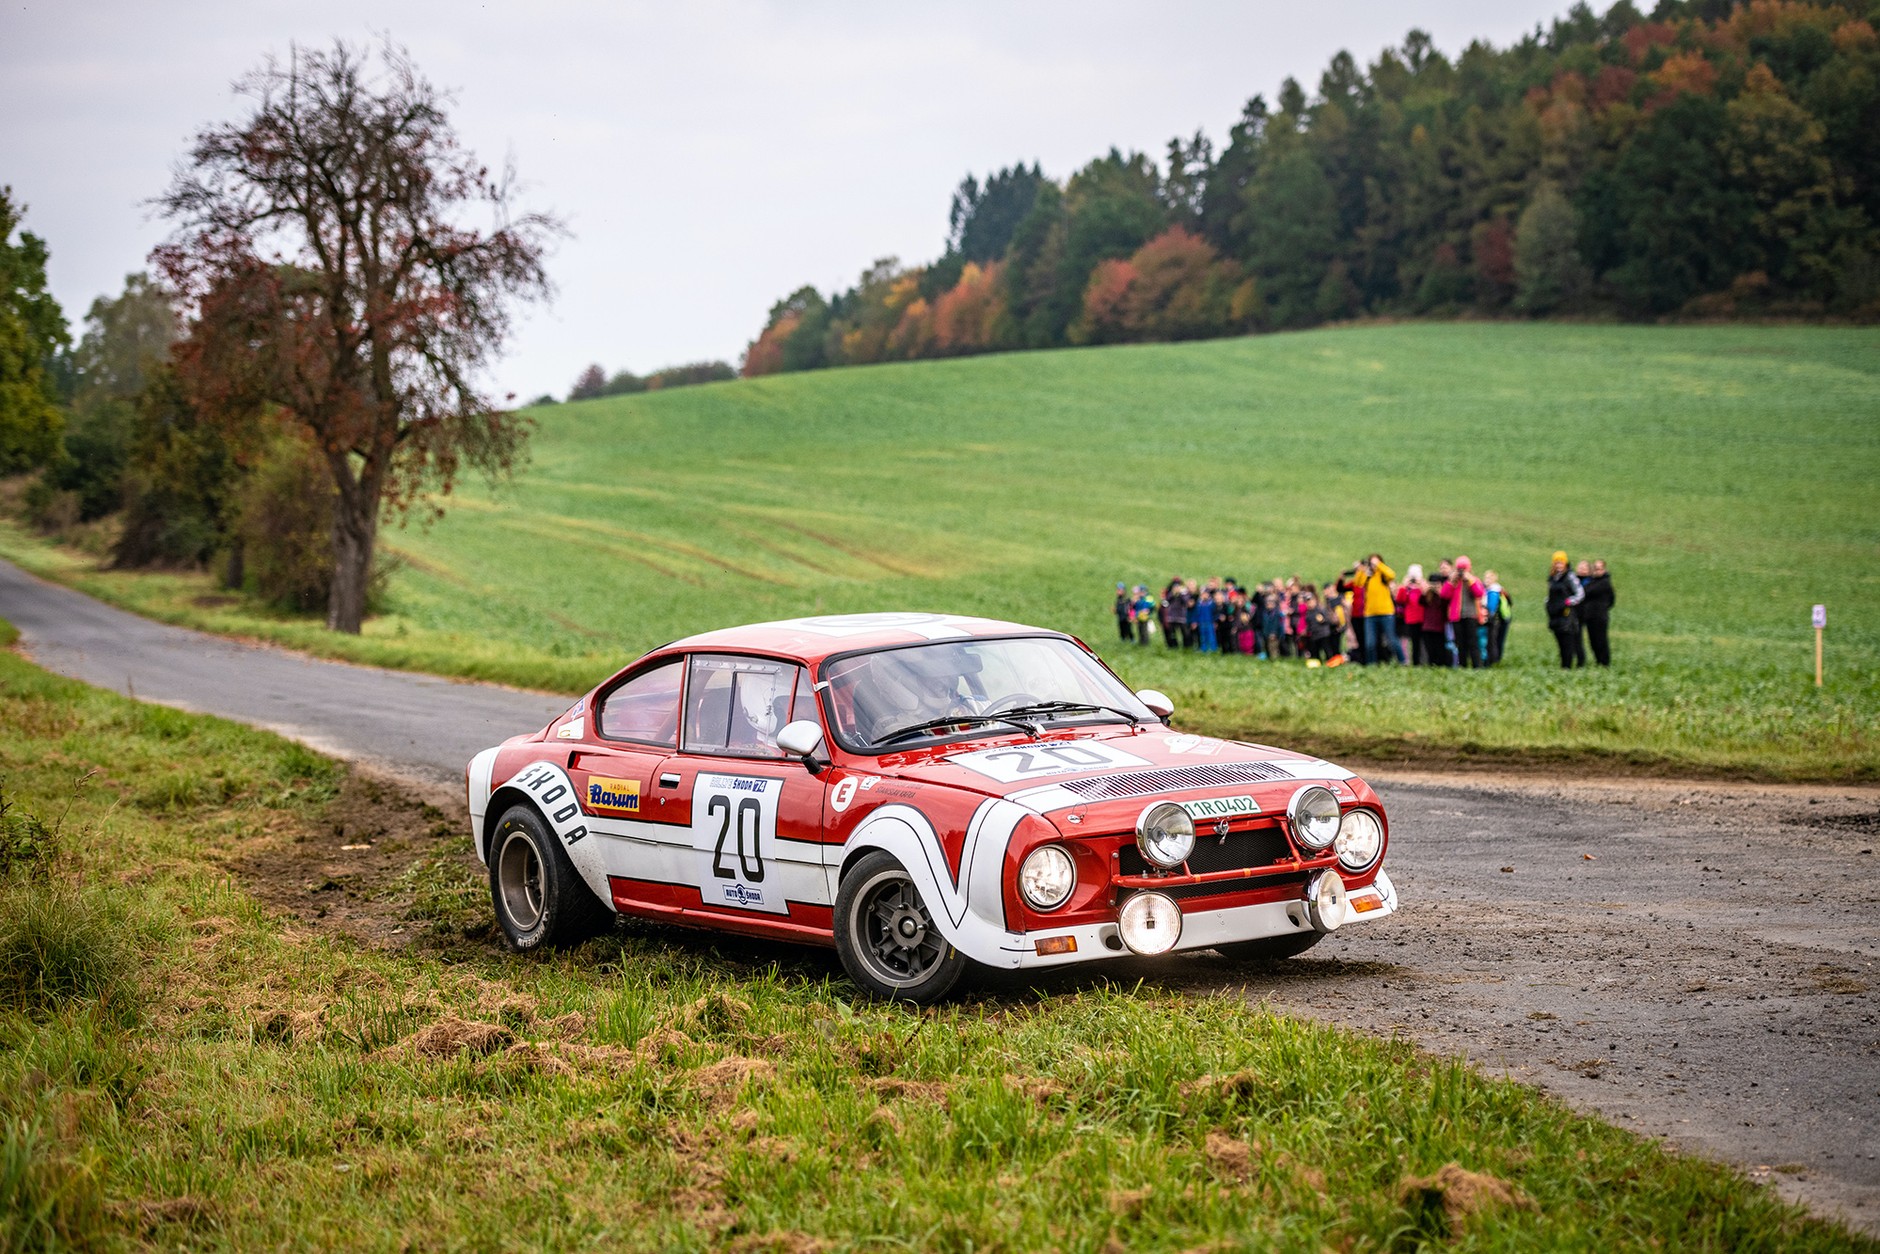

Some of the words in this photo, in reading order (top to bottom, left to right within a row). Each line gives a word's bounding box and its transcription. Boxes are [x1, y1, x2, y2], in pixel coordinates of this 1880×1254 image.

[985, 746, 1113, 774] 20
[589, 783, 639, 809] Barum
[610, 783, 630, 792] RADIAL
[836, 783, 852, 803] E
[708, 794, 765, 883] 20
